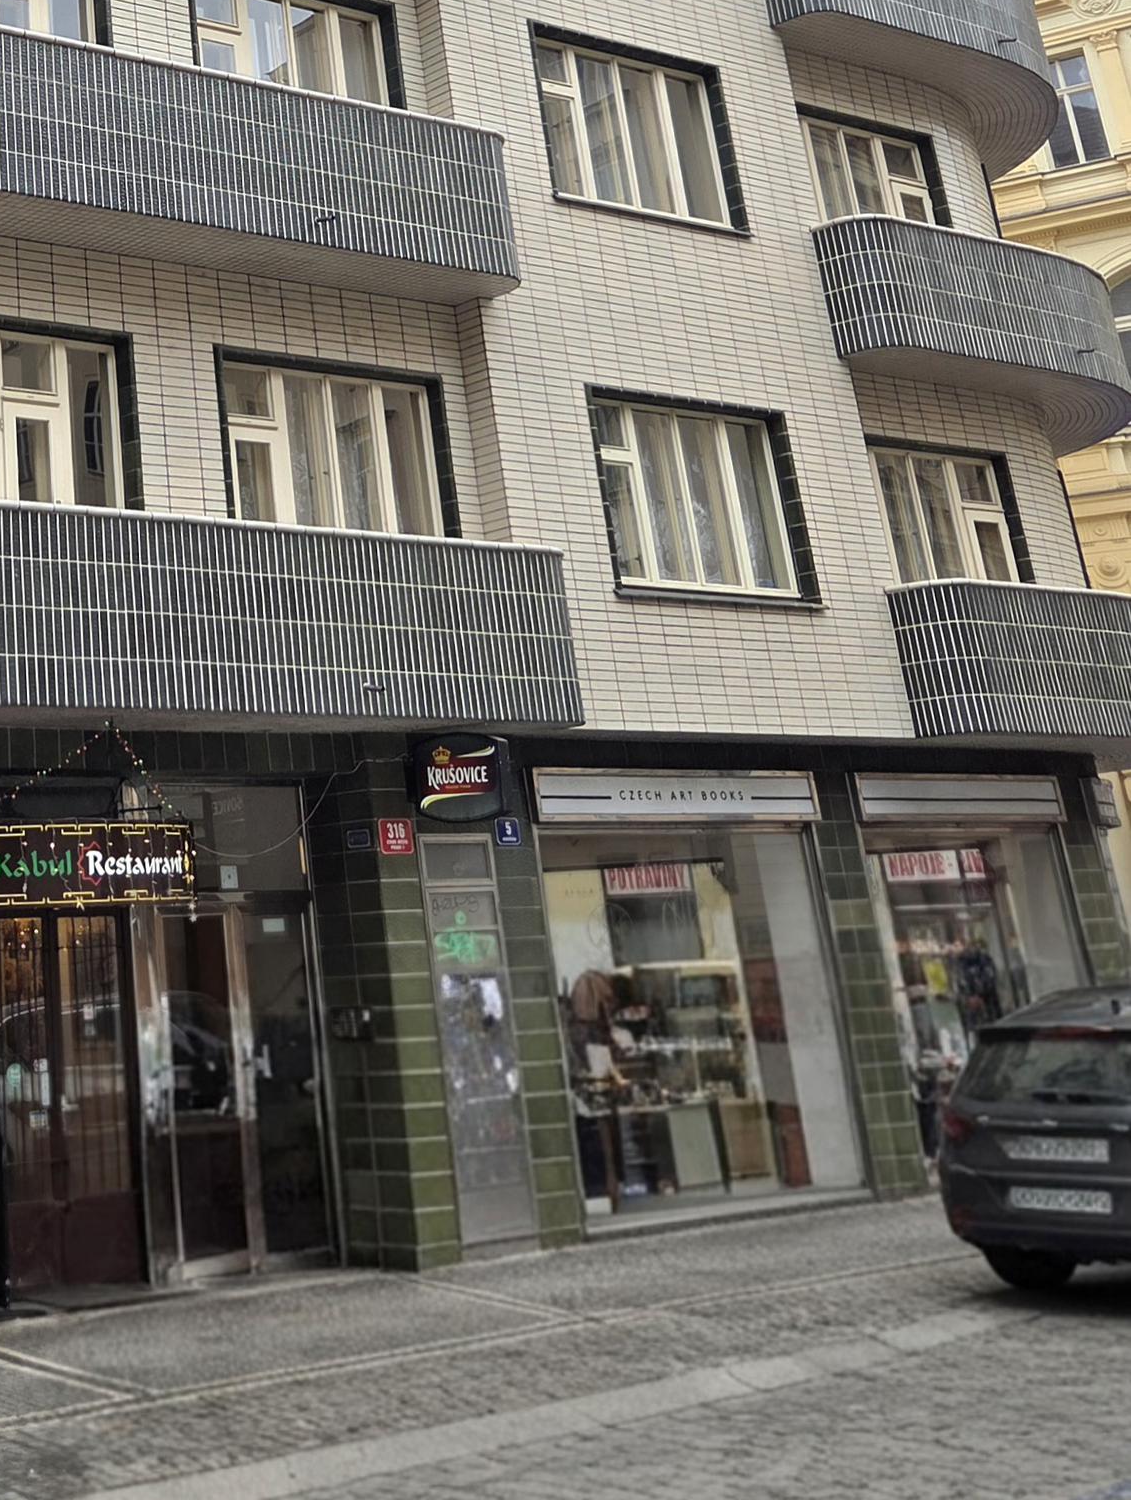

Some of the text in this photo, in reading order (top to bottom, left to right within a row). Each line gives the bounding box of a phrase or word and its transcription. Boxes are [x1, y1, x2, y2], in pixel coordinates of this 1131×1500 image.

[427, 764, 488, 790] KRUŠOVICE
[619, 790, 744, 801] CZECH ART BOOKS
[386, 822, 406, 839] 316
[504, 821, 512, 836] 5
[86, 850, 184, 876] Restaurant
[888, 852, 945, 877] NAPOJE
[608, 865, 686, 891] POTRAVINY
